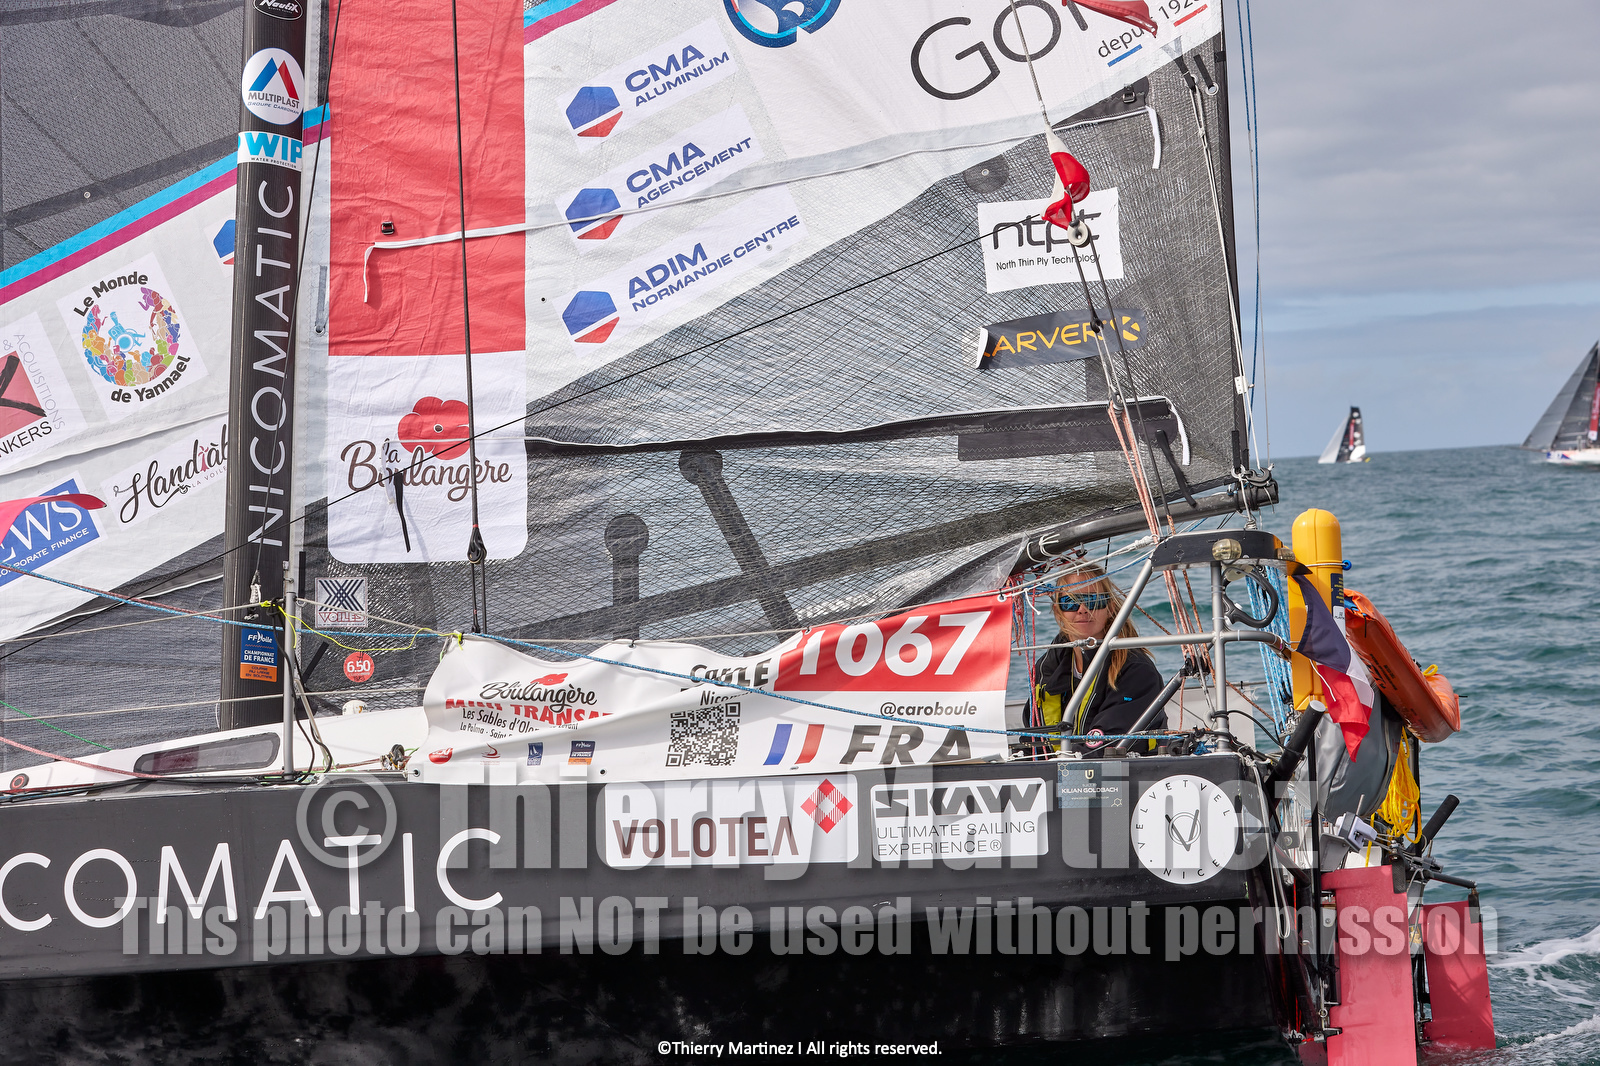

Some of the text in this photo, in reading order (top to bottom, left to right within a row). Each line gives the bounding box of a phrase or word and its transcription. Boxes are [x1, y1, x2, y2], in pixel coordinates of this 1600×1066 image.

[1158, 0, 1200, 19] 192
[625, 44, 705, 92] CMA
[635, 51, 730, 107] ALUMINIUM
[248, 91, 300, 110] MULTIPLAST
[244, 132, 302, 164] WIP
[270, 158, 297, 169] PROTECTION
[626, 142, 706, 193] CMA
[638, 137, 752, 209] AGENCEMENT
[628, 242, 708, 300] ADIM
[632, 215, 800, 312] NORMANDIE CENTRE
[996, 253, 1101, 271] North Thin Ply Technology
[73, 271, 149, 318] Le Monde
[983, 322, 1104, 357] ARVER
[13, 333, 66, 431] ACQUISITIONS
[110, 355, 191, 403] de Yannael
[247, 180, 294, 547] NICOMATIC
[51, 527, 90, 551] FINANCE
[319, 611, 366, 623] VOILES
[253, 655, 275, 664] FRANCE
[801, 610, 992, 677] 1067
[346, 659, 371, 673] 6.50
[480, 681, 598, 713] Boulangère
[880, 701, 978, 718] @caroboule
[462, 707, 475, 719] Les
[476, 709, 507, 728] Sables
[839, 725, 972, 764] FRA
[612, 815, 799, 859] VOLOTEA
[876, 820, 1036, 840] ULTIMATE SAILING
[0, 828, 503, 932] COMATIC
